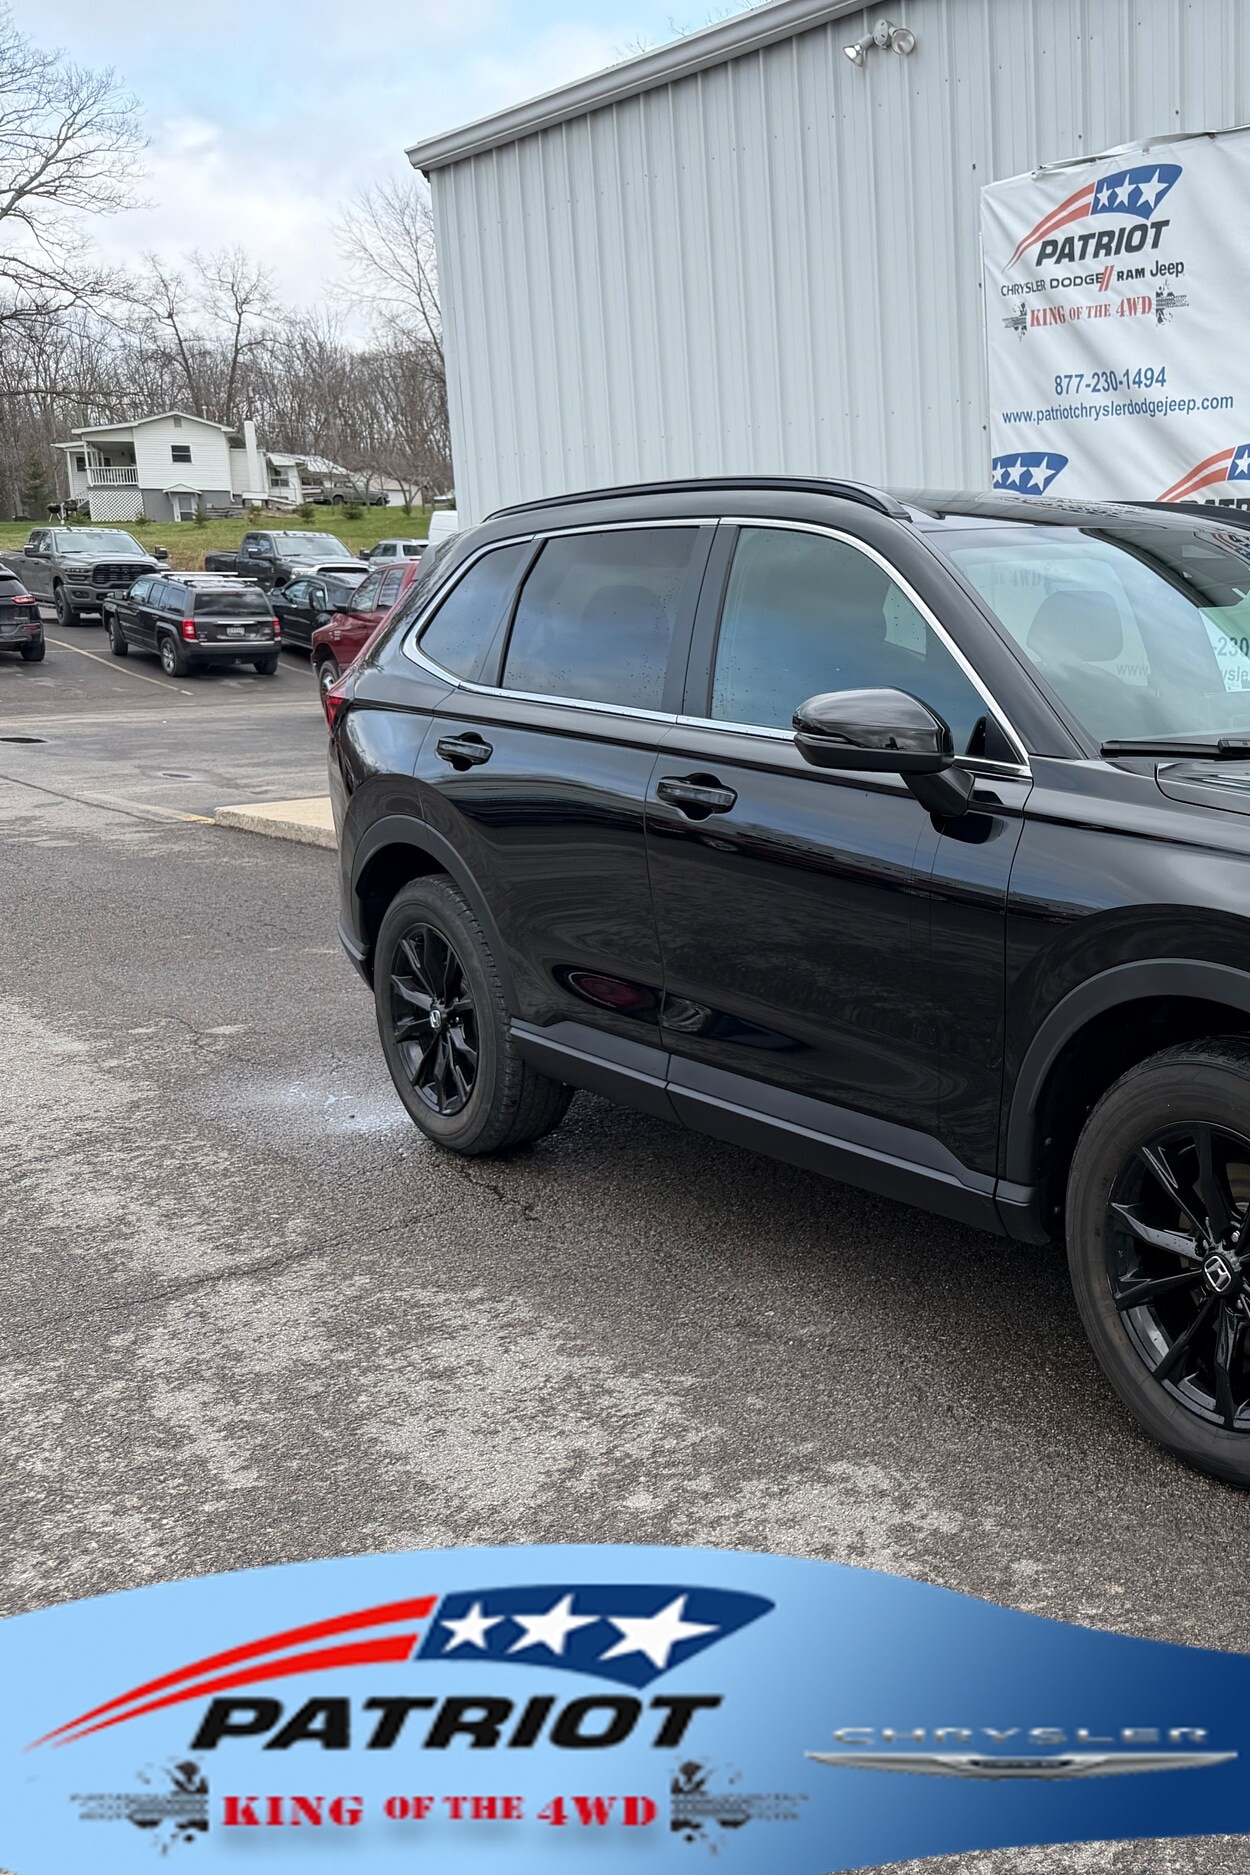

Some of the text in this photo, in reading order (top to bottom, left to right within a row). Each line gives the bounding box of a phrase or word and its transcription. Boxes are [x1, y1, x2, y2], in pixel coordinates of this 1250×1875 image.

[1036, 219, 1171, 267] PATRIOT
[1000, 259, 1185, 297] CHRYSLER DODGE RAM Jeep
[1029, 296, 1153, 328] KING OF THE 4WD
[1054, 366, 1167, 396] 877-230-1494
[1002, 393, 1234, 425] www.patriotchryslerdodgejeep.com
